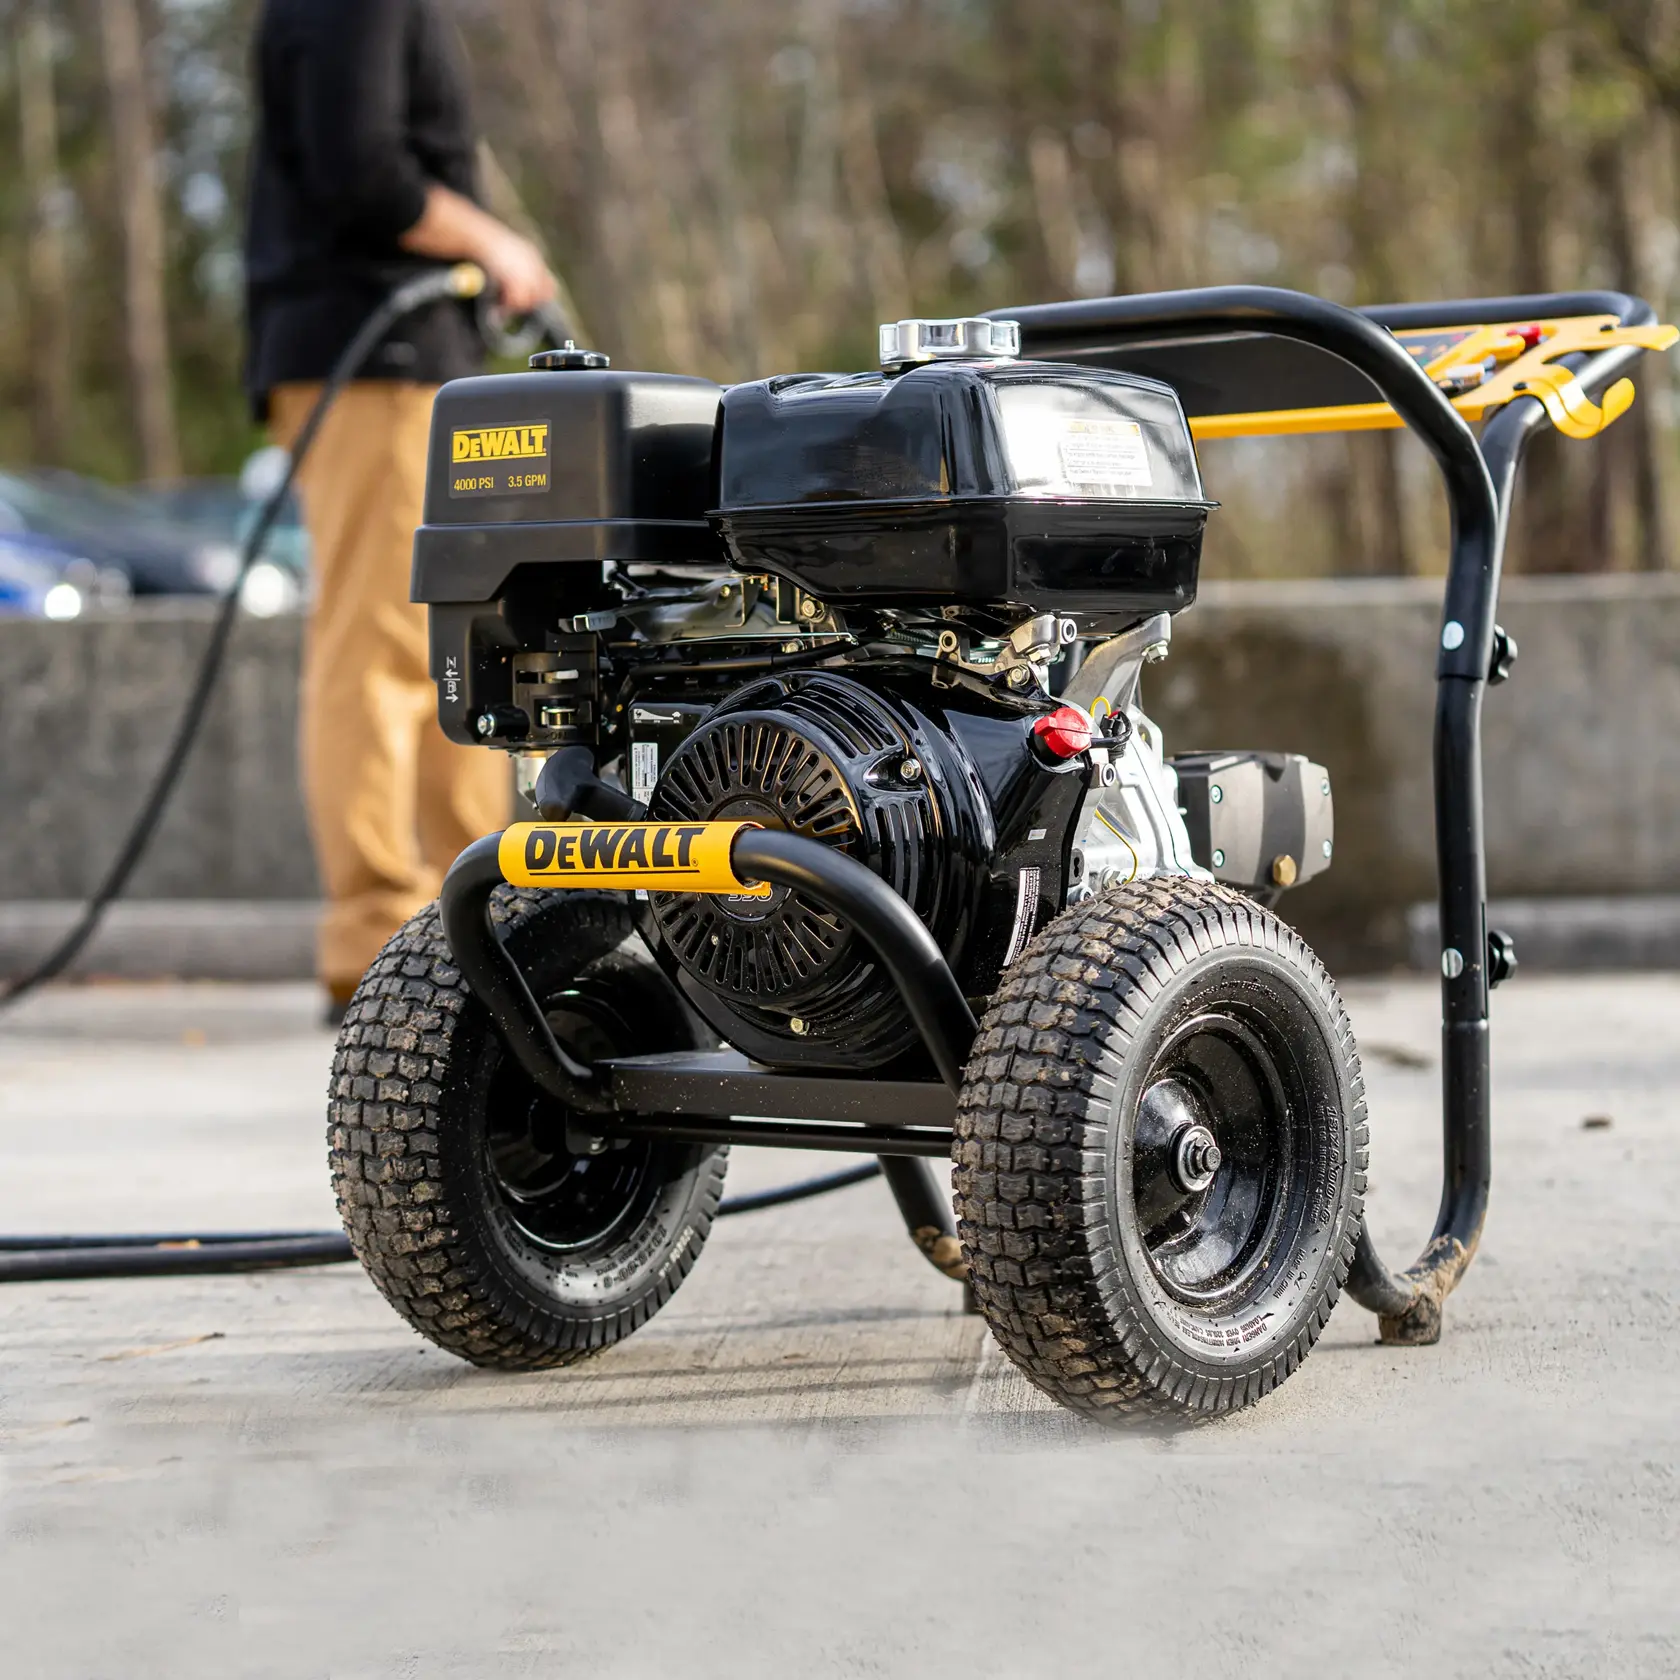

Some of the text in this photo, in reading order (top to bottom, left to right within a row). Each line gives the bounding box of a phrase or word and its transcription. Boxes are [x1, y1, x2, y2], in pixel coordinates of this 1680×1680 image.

[453, 428, 547, 459] DEWALT
[454, 477, 494, 490] 4000 PSI
[508, 474, 546, 487] 3.5 GPM
[525, 827, 706, 870] DEWALT
